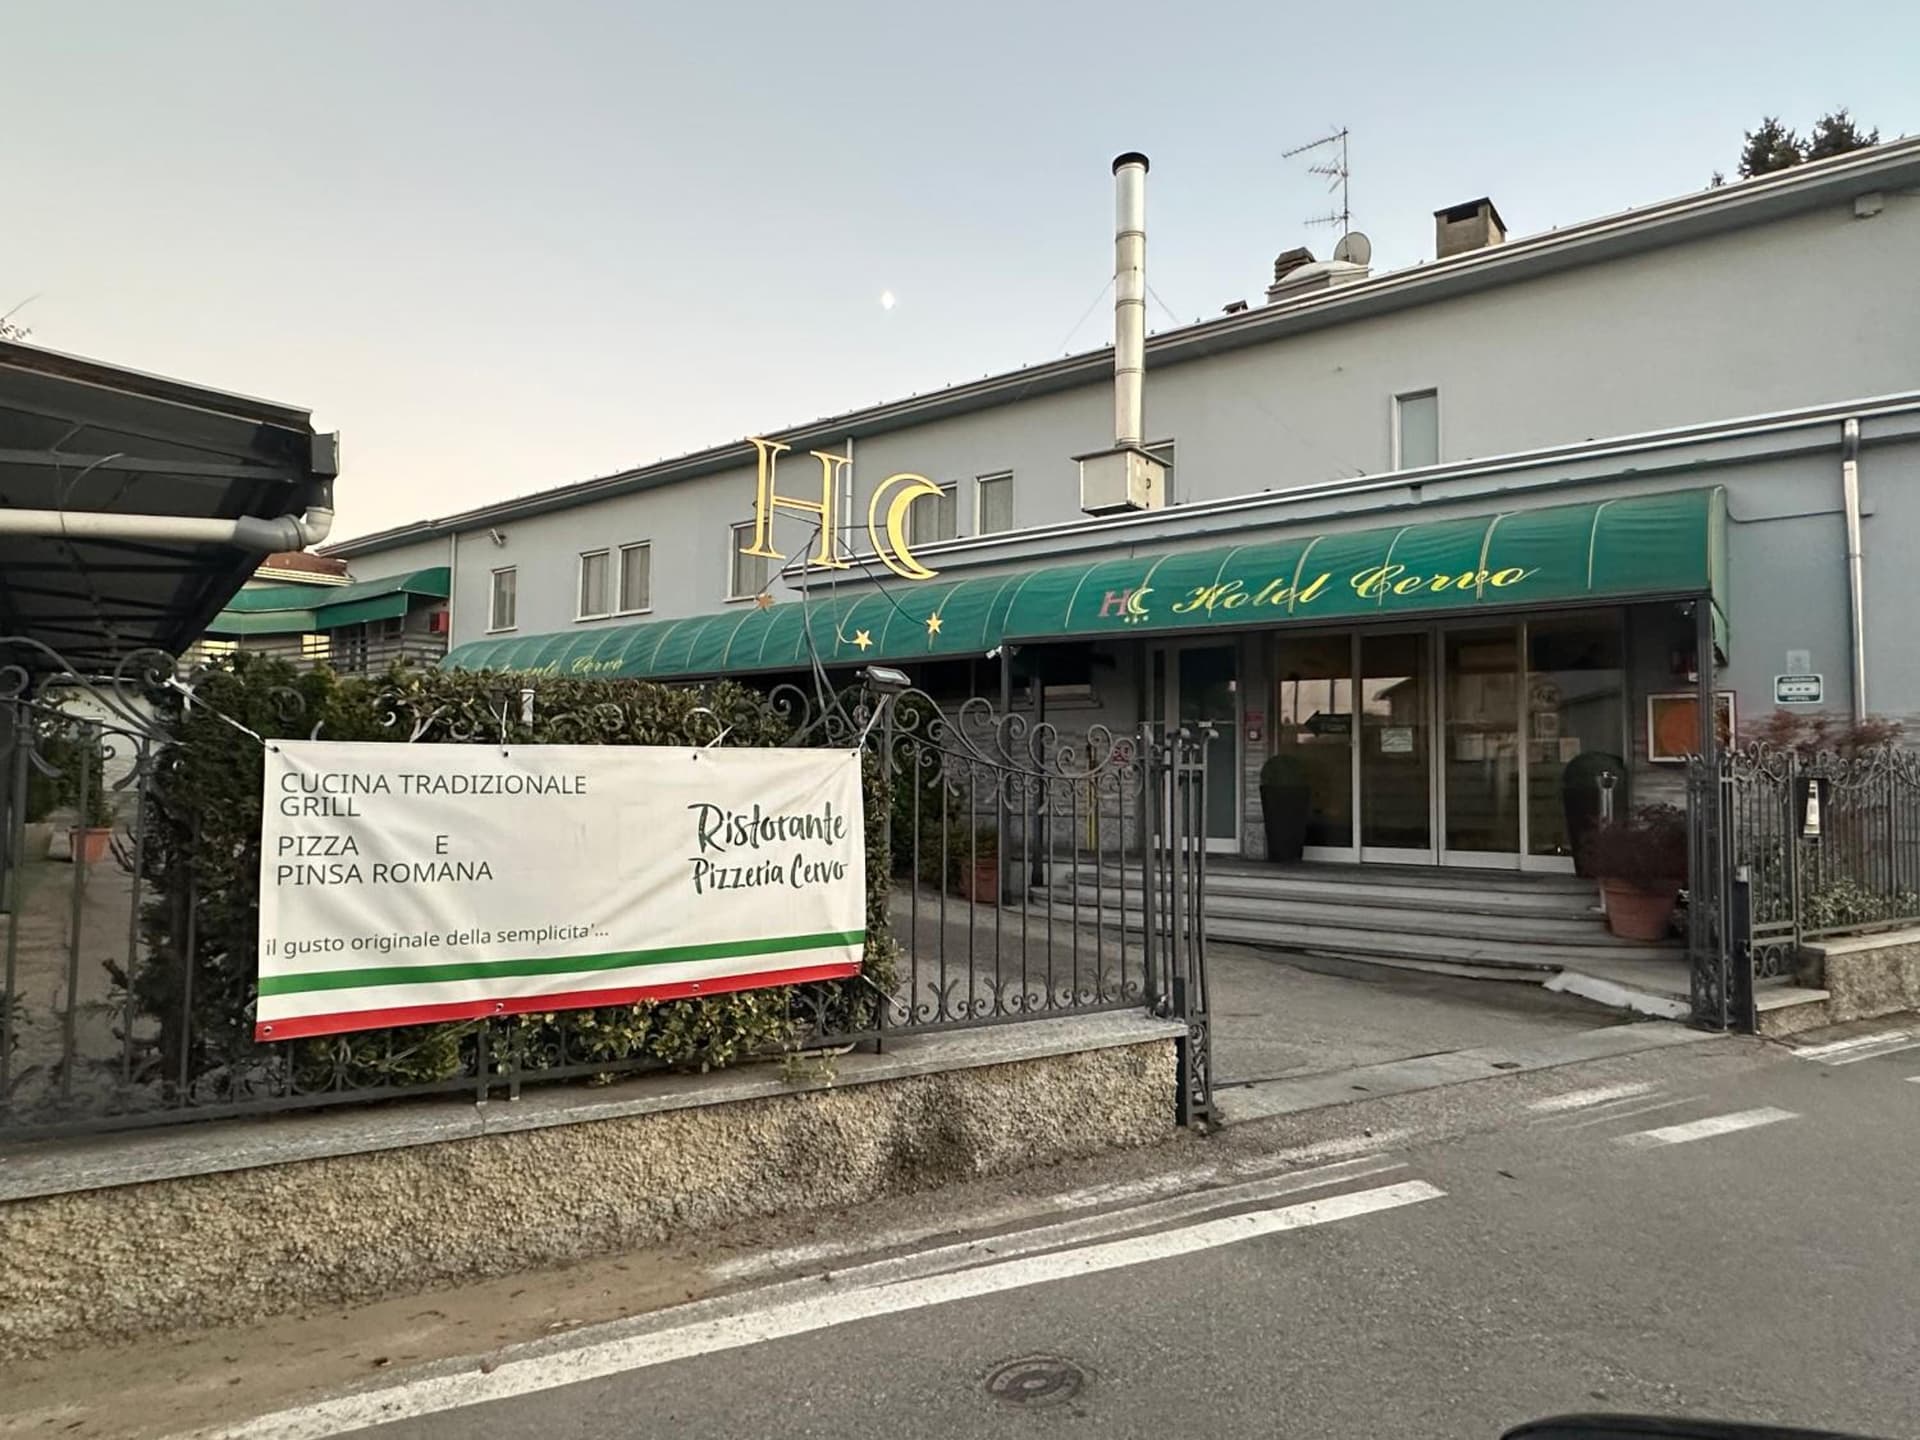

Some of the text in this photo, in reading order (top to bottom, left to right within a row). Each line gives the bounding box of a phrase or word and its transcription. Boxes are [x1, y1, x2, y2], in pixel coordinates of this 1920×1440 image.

[1172, 573, 1331, 613] Hotel
[1350, 564, 1541, 598] Cervo
[280, 772, 587, 795] CUCINA TRADIZIONALE
[280, 796, 361, 817] GRILL
[687, 801, 848, 853] Ristorante
[278, 834, 449, 857] PIZZA E
[277, 861, 493, 886] PINSA ROMANA
[688, 853, 849, 895] Pizzeria Cervo
[266, 938, 276, 956] il
[284, 938, 345, 960] gusto
[351, 931, 440, 954] originale
[446, 929, 491, 946] della
